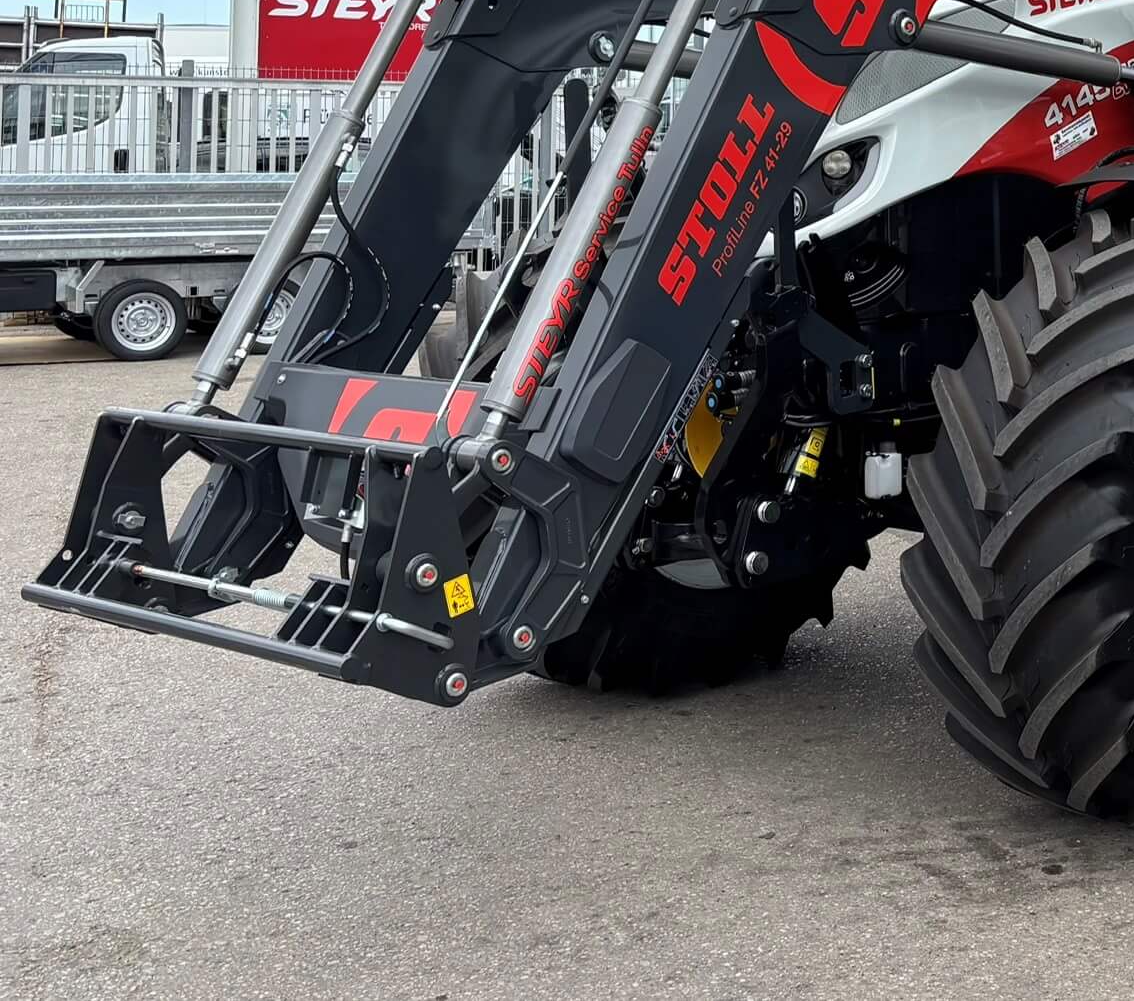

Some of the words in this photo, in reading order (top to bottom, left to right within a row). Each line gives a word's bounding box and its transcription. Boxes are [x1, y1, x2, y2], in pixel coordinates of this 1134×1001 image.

[513, 278, 581, 406] STEYR
[573, 185, 625, 281] Service
[617, 125, 655, 182] Tulln
[658, 93, 776, 307] STOLL
[711, 199, 755, 278] ProfiLine
[750, 169, 769, 199] FZ
[764, 121, 793, 172] 41-29
